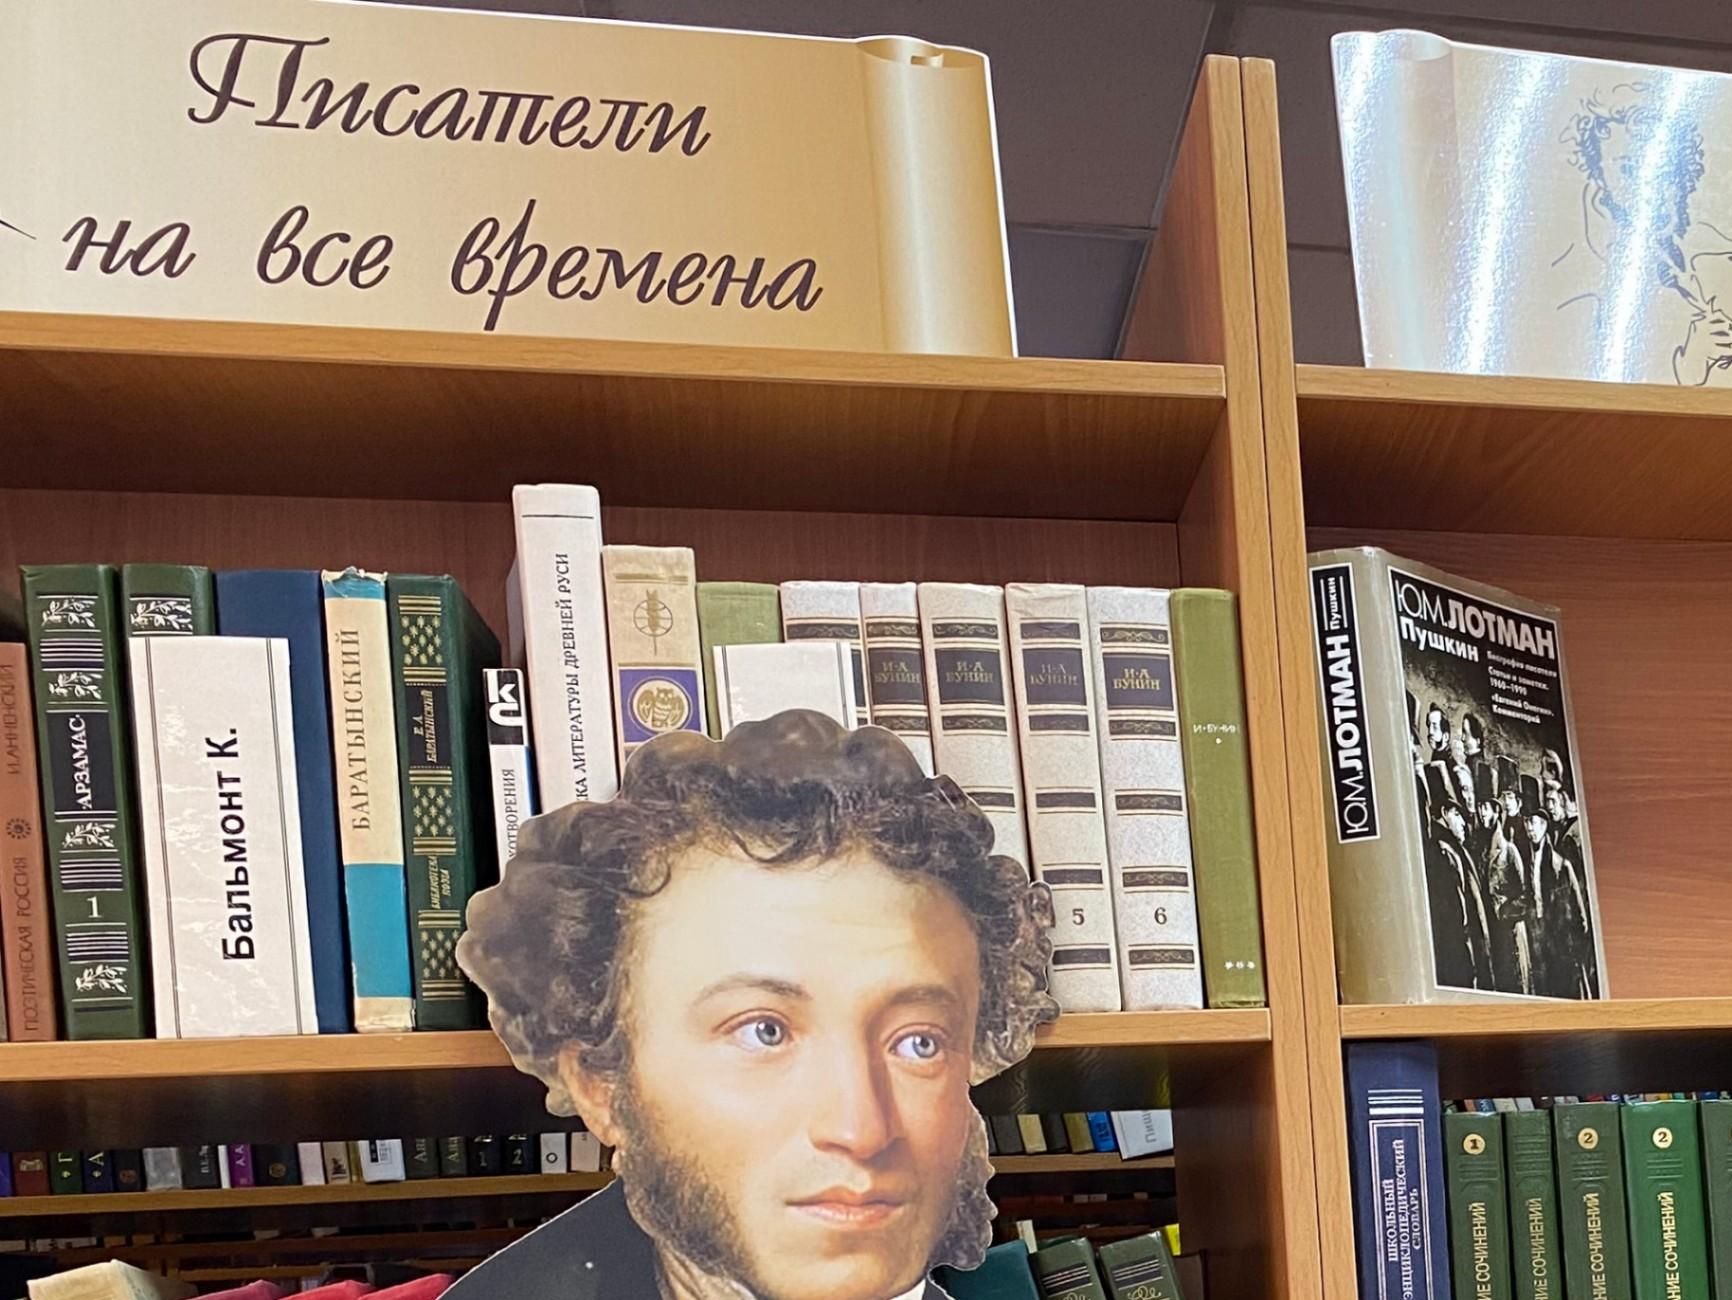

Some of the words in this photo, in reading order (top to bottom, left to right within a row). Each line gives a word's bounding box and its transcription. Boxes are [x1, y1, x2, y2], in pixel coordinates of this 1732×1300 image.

[187, 33, 712, 157] Писатели
[63, 214, 197, 279] на
[256, 204, 396, 290] все
[451, 198, 822, 332] времена
[555, 553, 570, 596] РУСИ
[1330, 576, 1340, 630] Пушкин
[555, 601, 580, 669] ДРЕВНЕЙ
[1400, 615, 1479, 662] Пушкин
[1113, 677, 1160, 690] БУНИН
[206, 727, 240, 758] К.
[336, 630, 370, 831] БАРАТЫНСКИЙ
[565, 673, 587, 772] ЛИТЕРАТУРЫ
[69, 714, 93, 810] АРЗАМАС
[16, 856, 31, 918] РОССИЯ
[217, 770, 255, 961] Бальмонт
[87, 897, 98, 918] 1
[1072, 907, 1085, 926] 5
[23, 925, 39, 1032] ПОЭТИЧЕСКАЯ
[1384, 1179, 1399, 1262] ШКОЛЬНЫЙ
[1393, 1140, 1413, 1300] ЭНЦИКЛОПЕДИЧЕСКИЙ
[1411, 1188, 1422, 1250] СЛОВАРЬ
[1658, 1192, 1680, 1271] СОЧИНЕНИЙ
